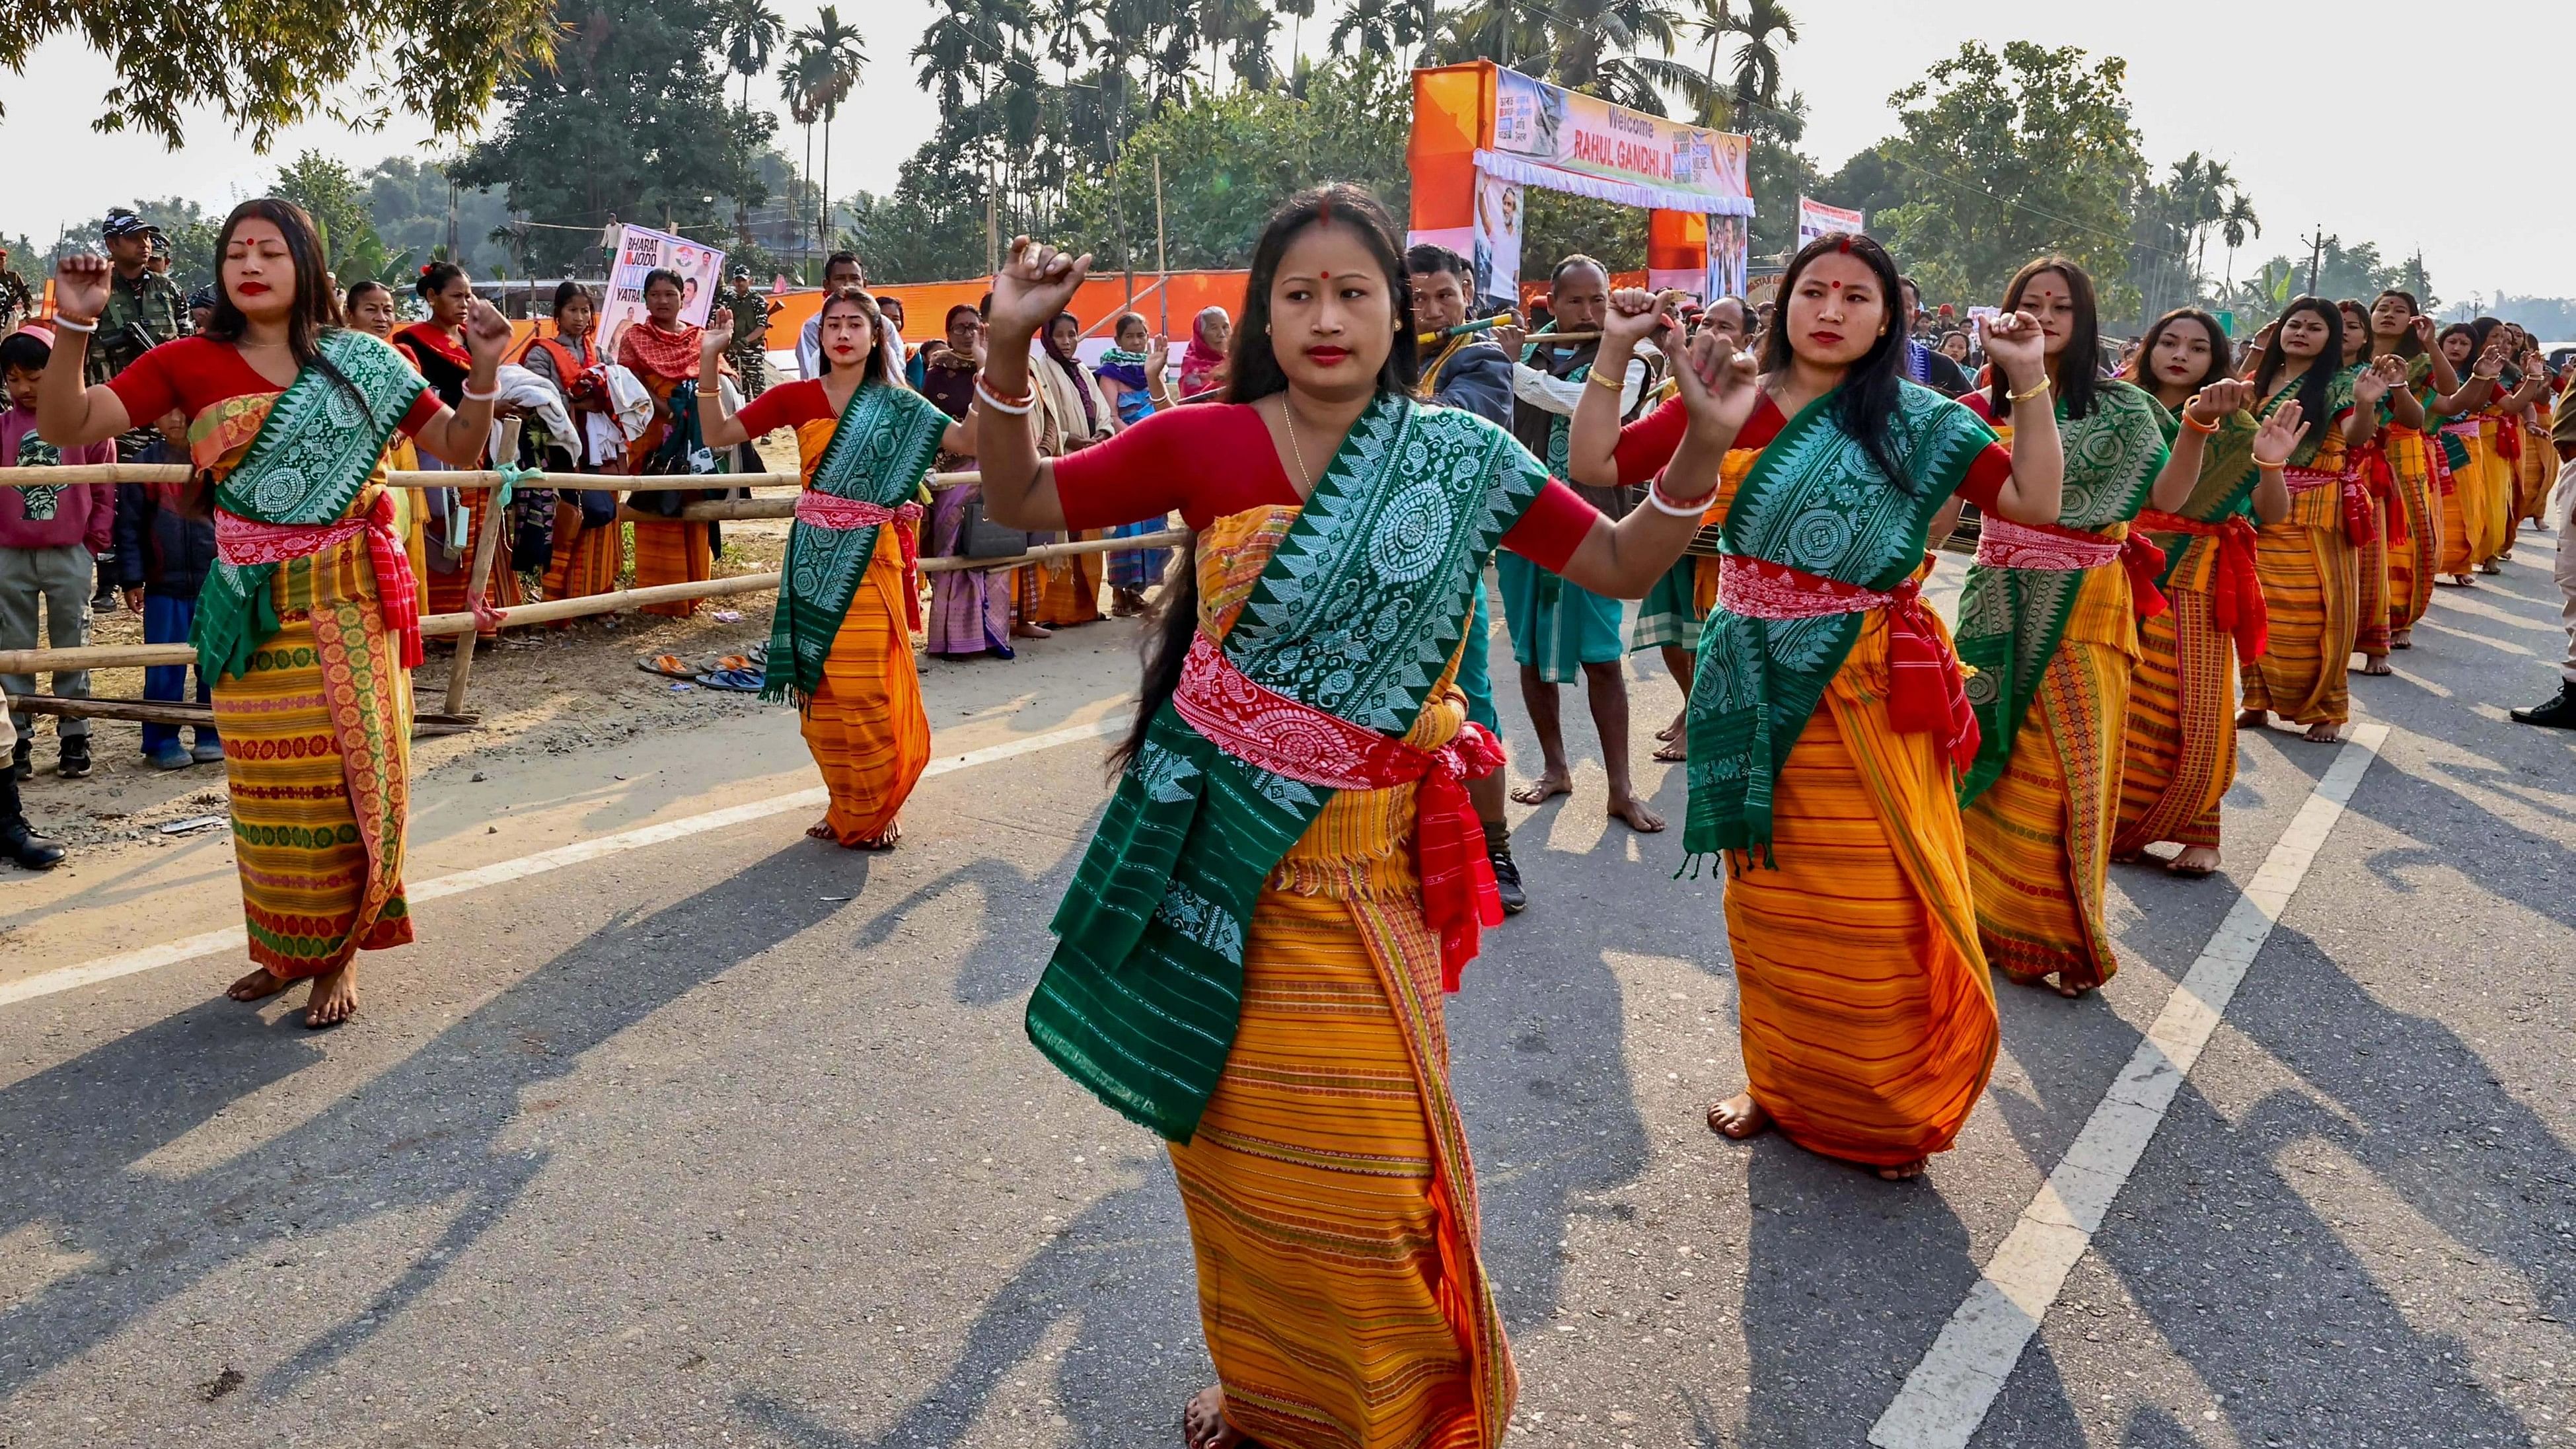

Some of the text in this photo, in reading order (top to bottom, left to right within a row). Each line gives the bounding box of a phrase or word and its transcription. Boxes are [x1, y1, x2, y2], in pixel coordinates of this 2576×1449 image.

[1609, 106, 1654, 139] Welcome
[1574, 130, 1614, 167] RAHUL
[1617, 141, 1659, 177] GANDHI
[1662, 152, 1672, 180] JI
[628, 237, 659, 252] BHARAT
[632, 252, 657, 267] JODO
[616, 287, 640, 303] YATRA
